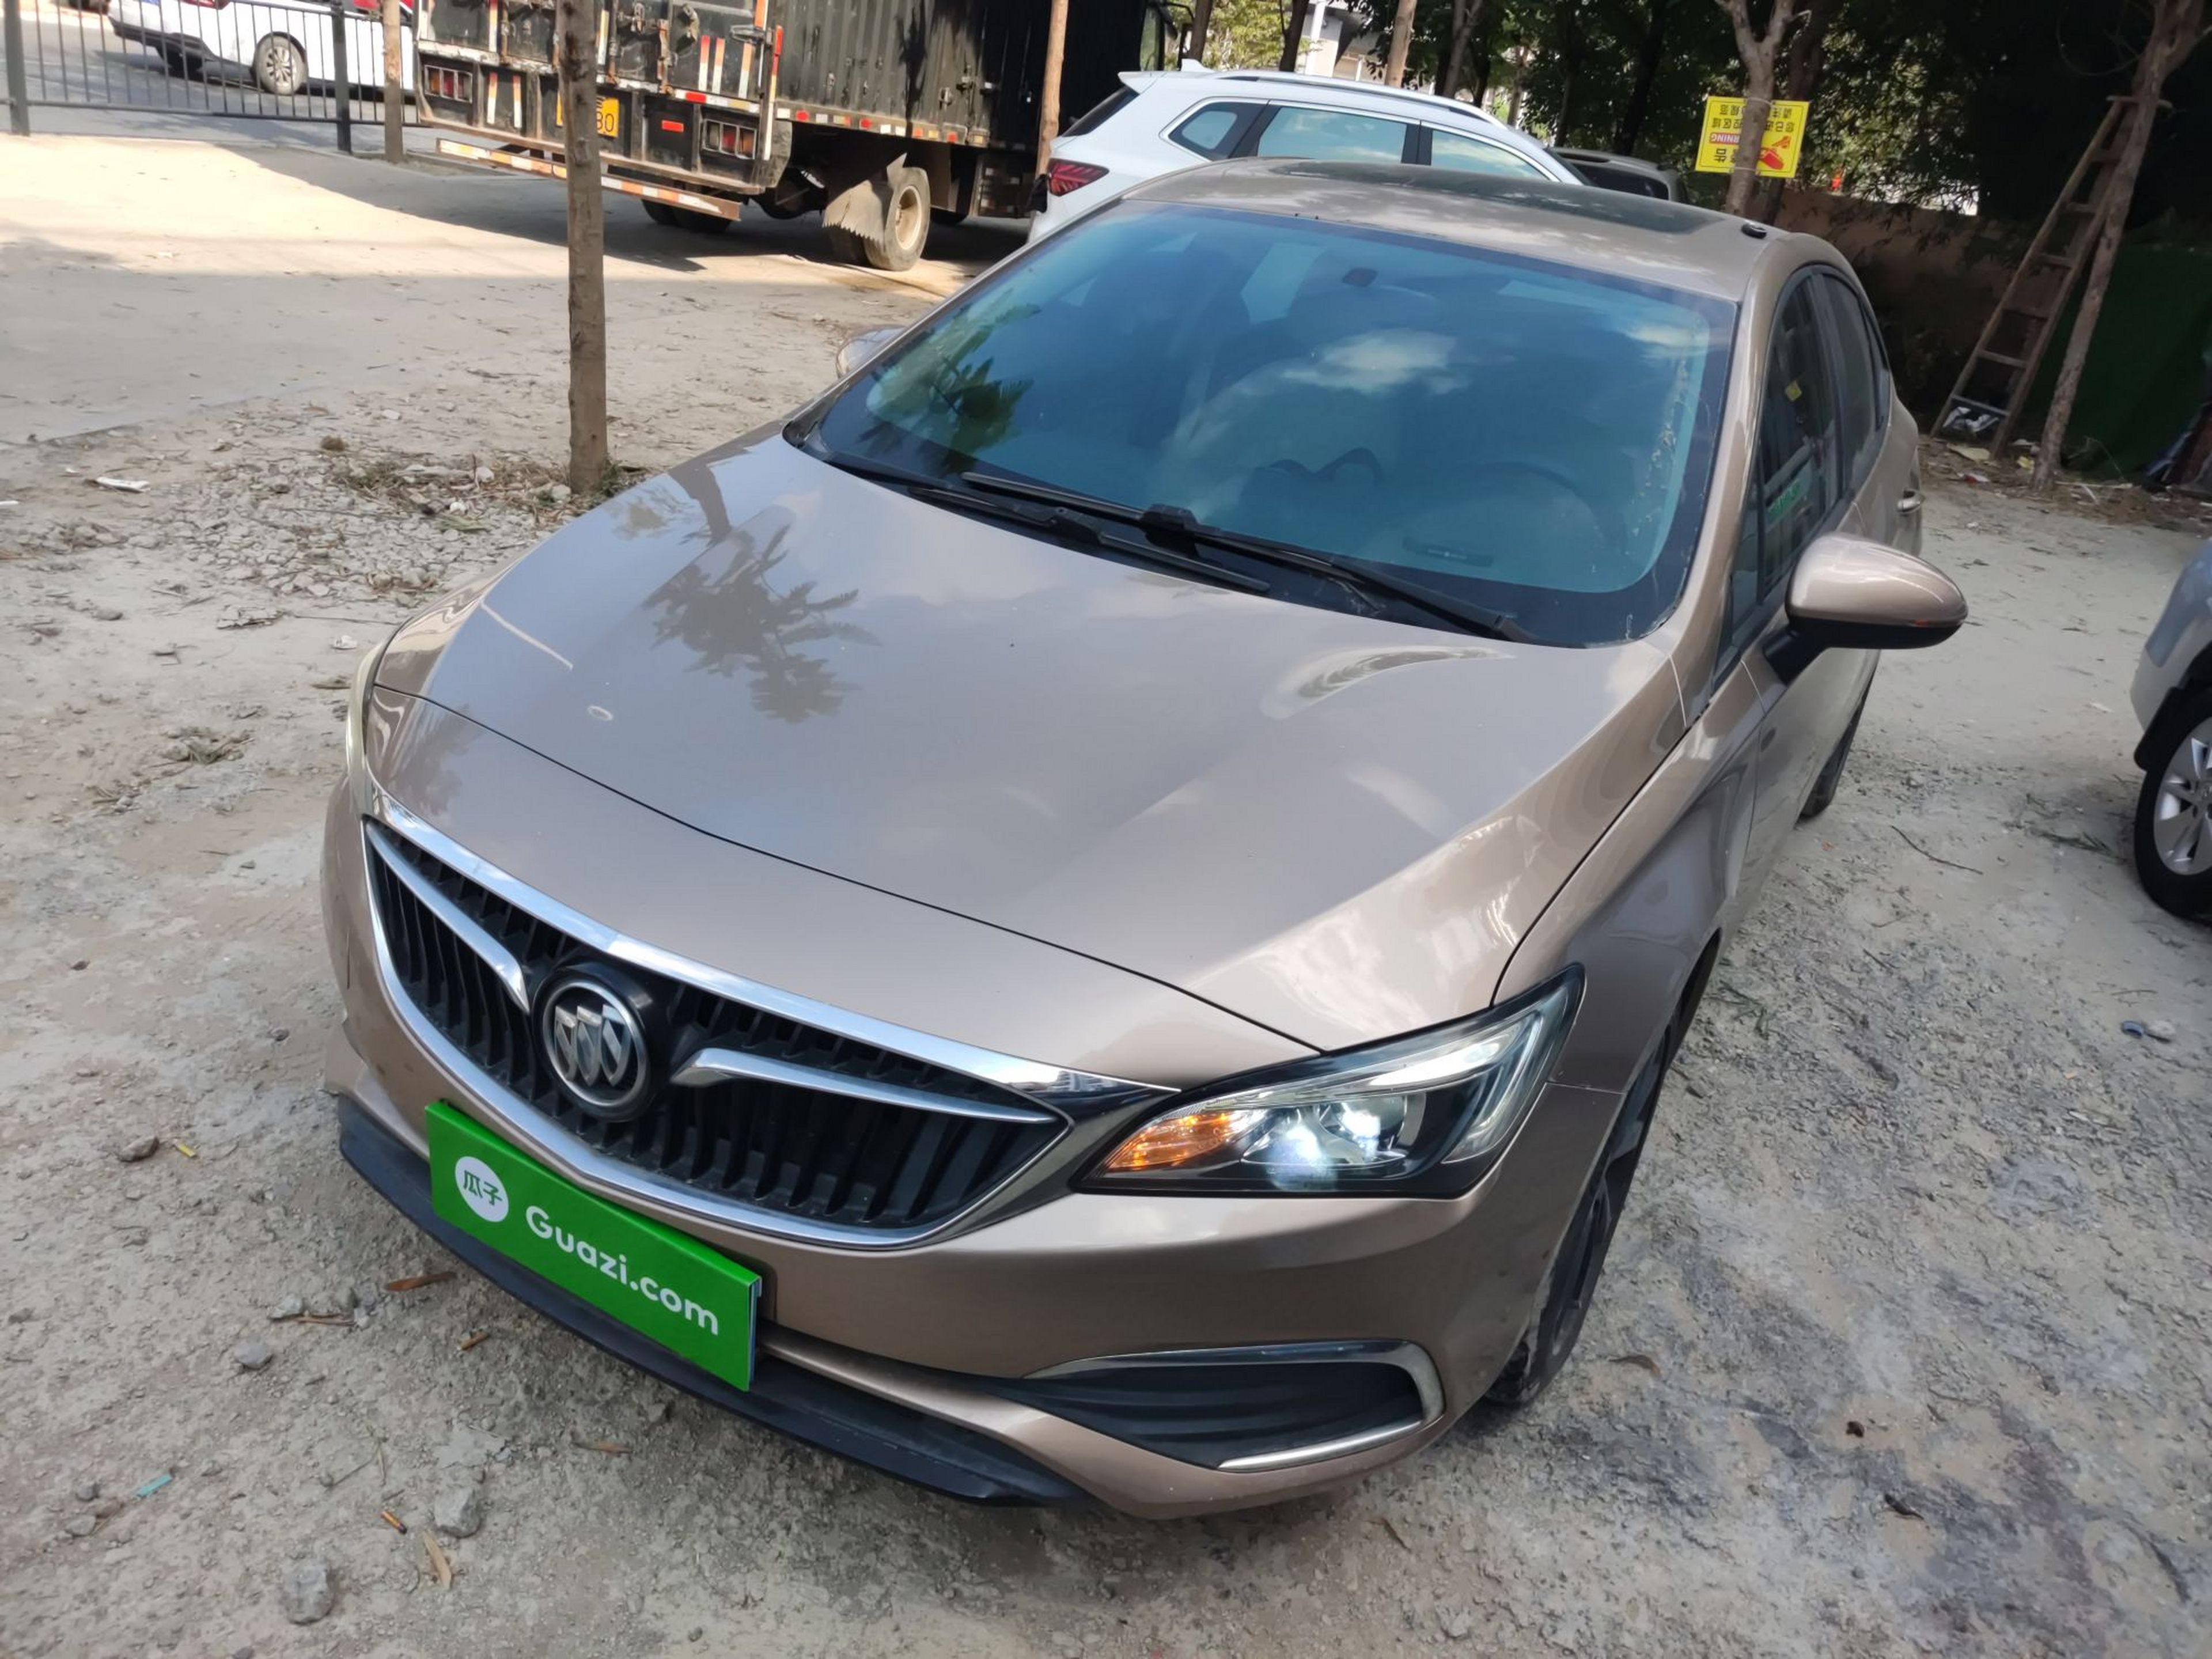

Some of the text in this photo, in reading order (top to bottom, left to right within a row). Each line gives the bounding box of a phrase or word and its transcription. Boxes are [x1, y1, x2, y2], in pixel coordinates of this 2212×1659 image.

[1710, 133, 1740, 143] RNING
[464, 1169, 503, 1206] 瓜子
[526, 1206, 718, 1336] Guazi.com
